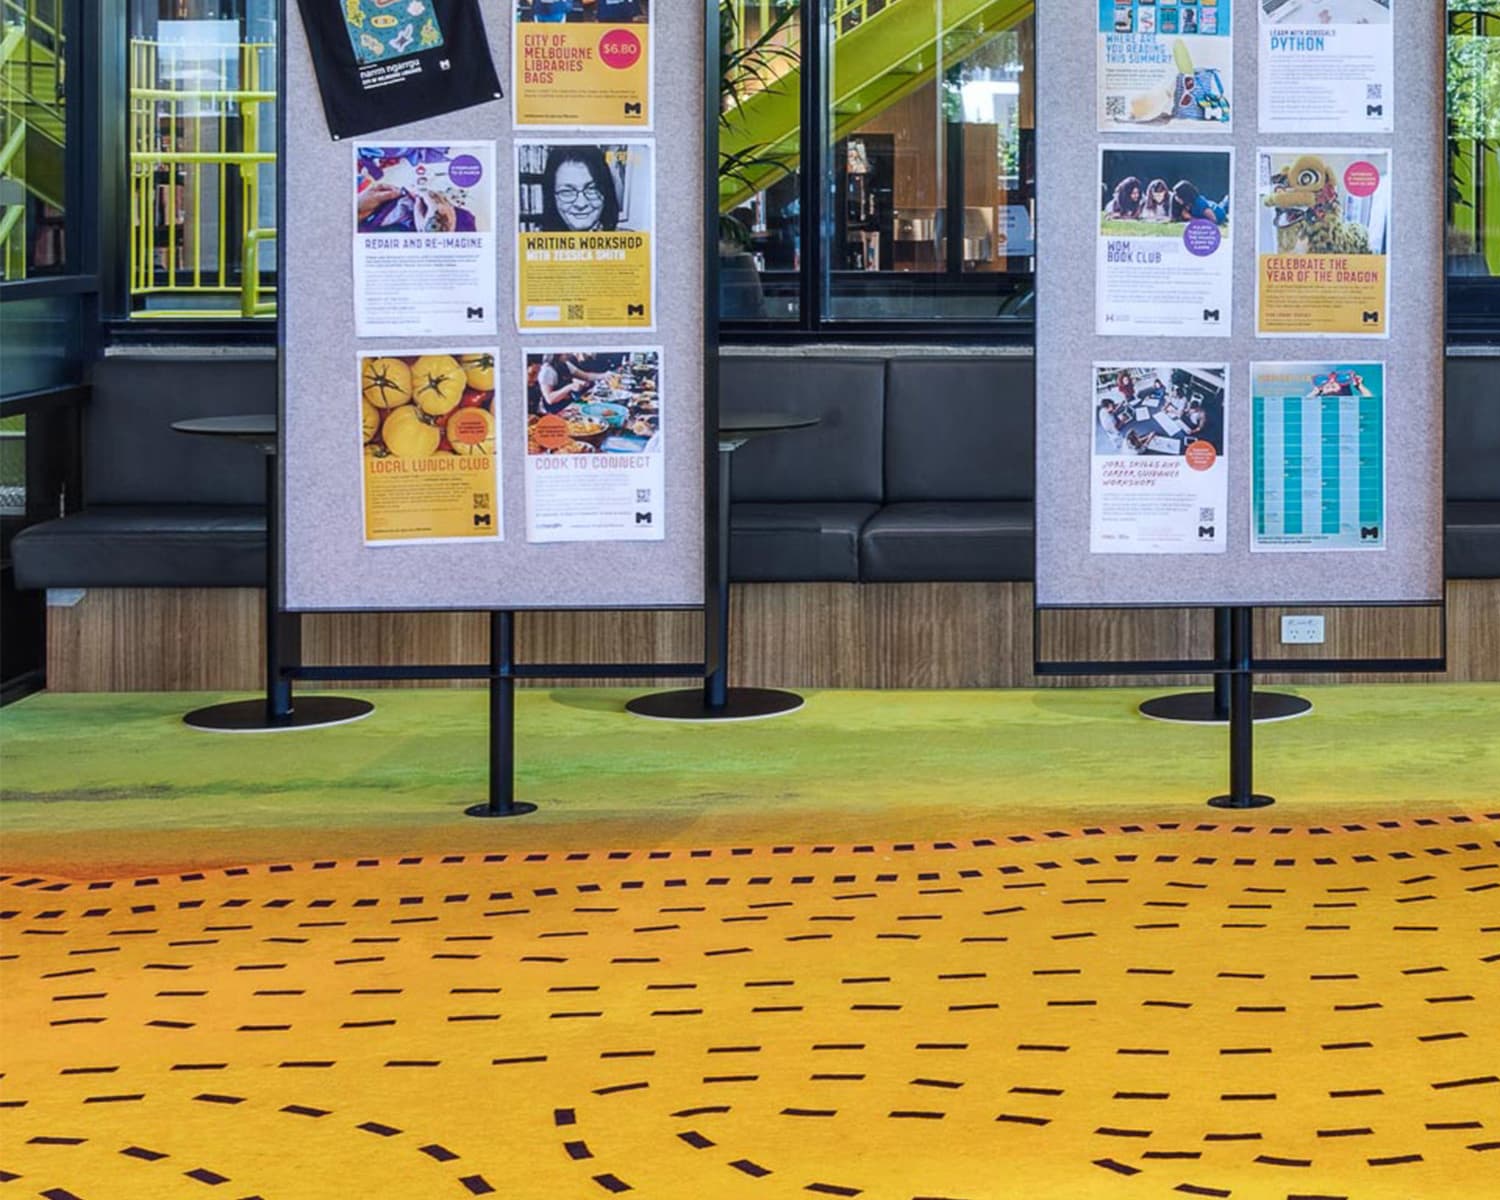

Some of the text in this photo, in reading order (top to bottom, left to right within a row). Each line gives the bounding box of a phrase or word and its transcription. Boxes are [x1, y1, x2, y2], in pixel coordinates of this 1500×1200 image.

[524, 34, 567, 47] CITY OF
[1271, 37, 1324, 51] PYTHON
[524, 47, 593, 60] MELBOURNE
[603, 43, 637, 55] $6.80
[1106, 43, 1124, 53] YOU
[1106, 53, 1126, 64] THIS
[524, 60, 583, 72] LIBRARIES
[524, 72, 554, 84] BAGS
[624, 102, 641, 114] M
[1366, 104, 1383, 116] M
[364, 238, 483, 249] REPAIR AND RE-IMAGINE
[526, 236, 643, 250] WRITING WORKSHOP
[1107, 240, 1130, 251] WOM
[1107, 252, 1162, 263] BOOK CLUB
[1266, 258, 1348, 270] CELEBRATE THE
[1266, 270, 1378, 283] YEAR OF THE DRAGON
[467, 307, 484, 319] M
[627, 304, 644, 316] M
[1203, 309, 1220, 321] M
[1363, 311, 1379, 323] M
[370, 457, 490, 474] LOCAL LUNCH CLUB
[535, 455, 651, 470] COOK TO CONNECT
[474, 514, 491, 525] M
[635, 512, 652, 523] M
[1198, 526, 1215, 538] M
[1361, 526, 1379, 539] M
